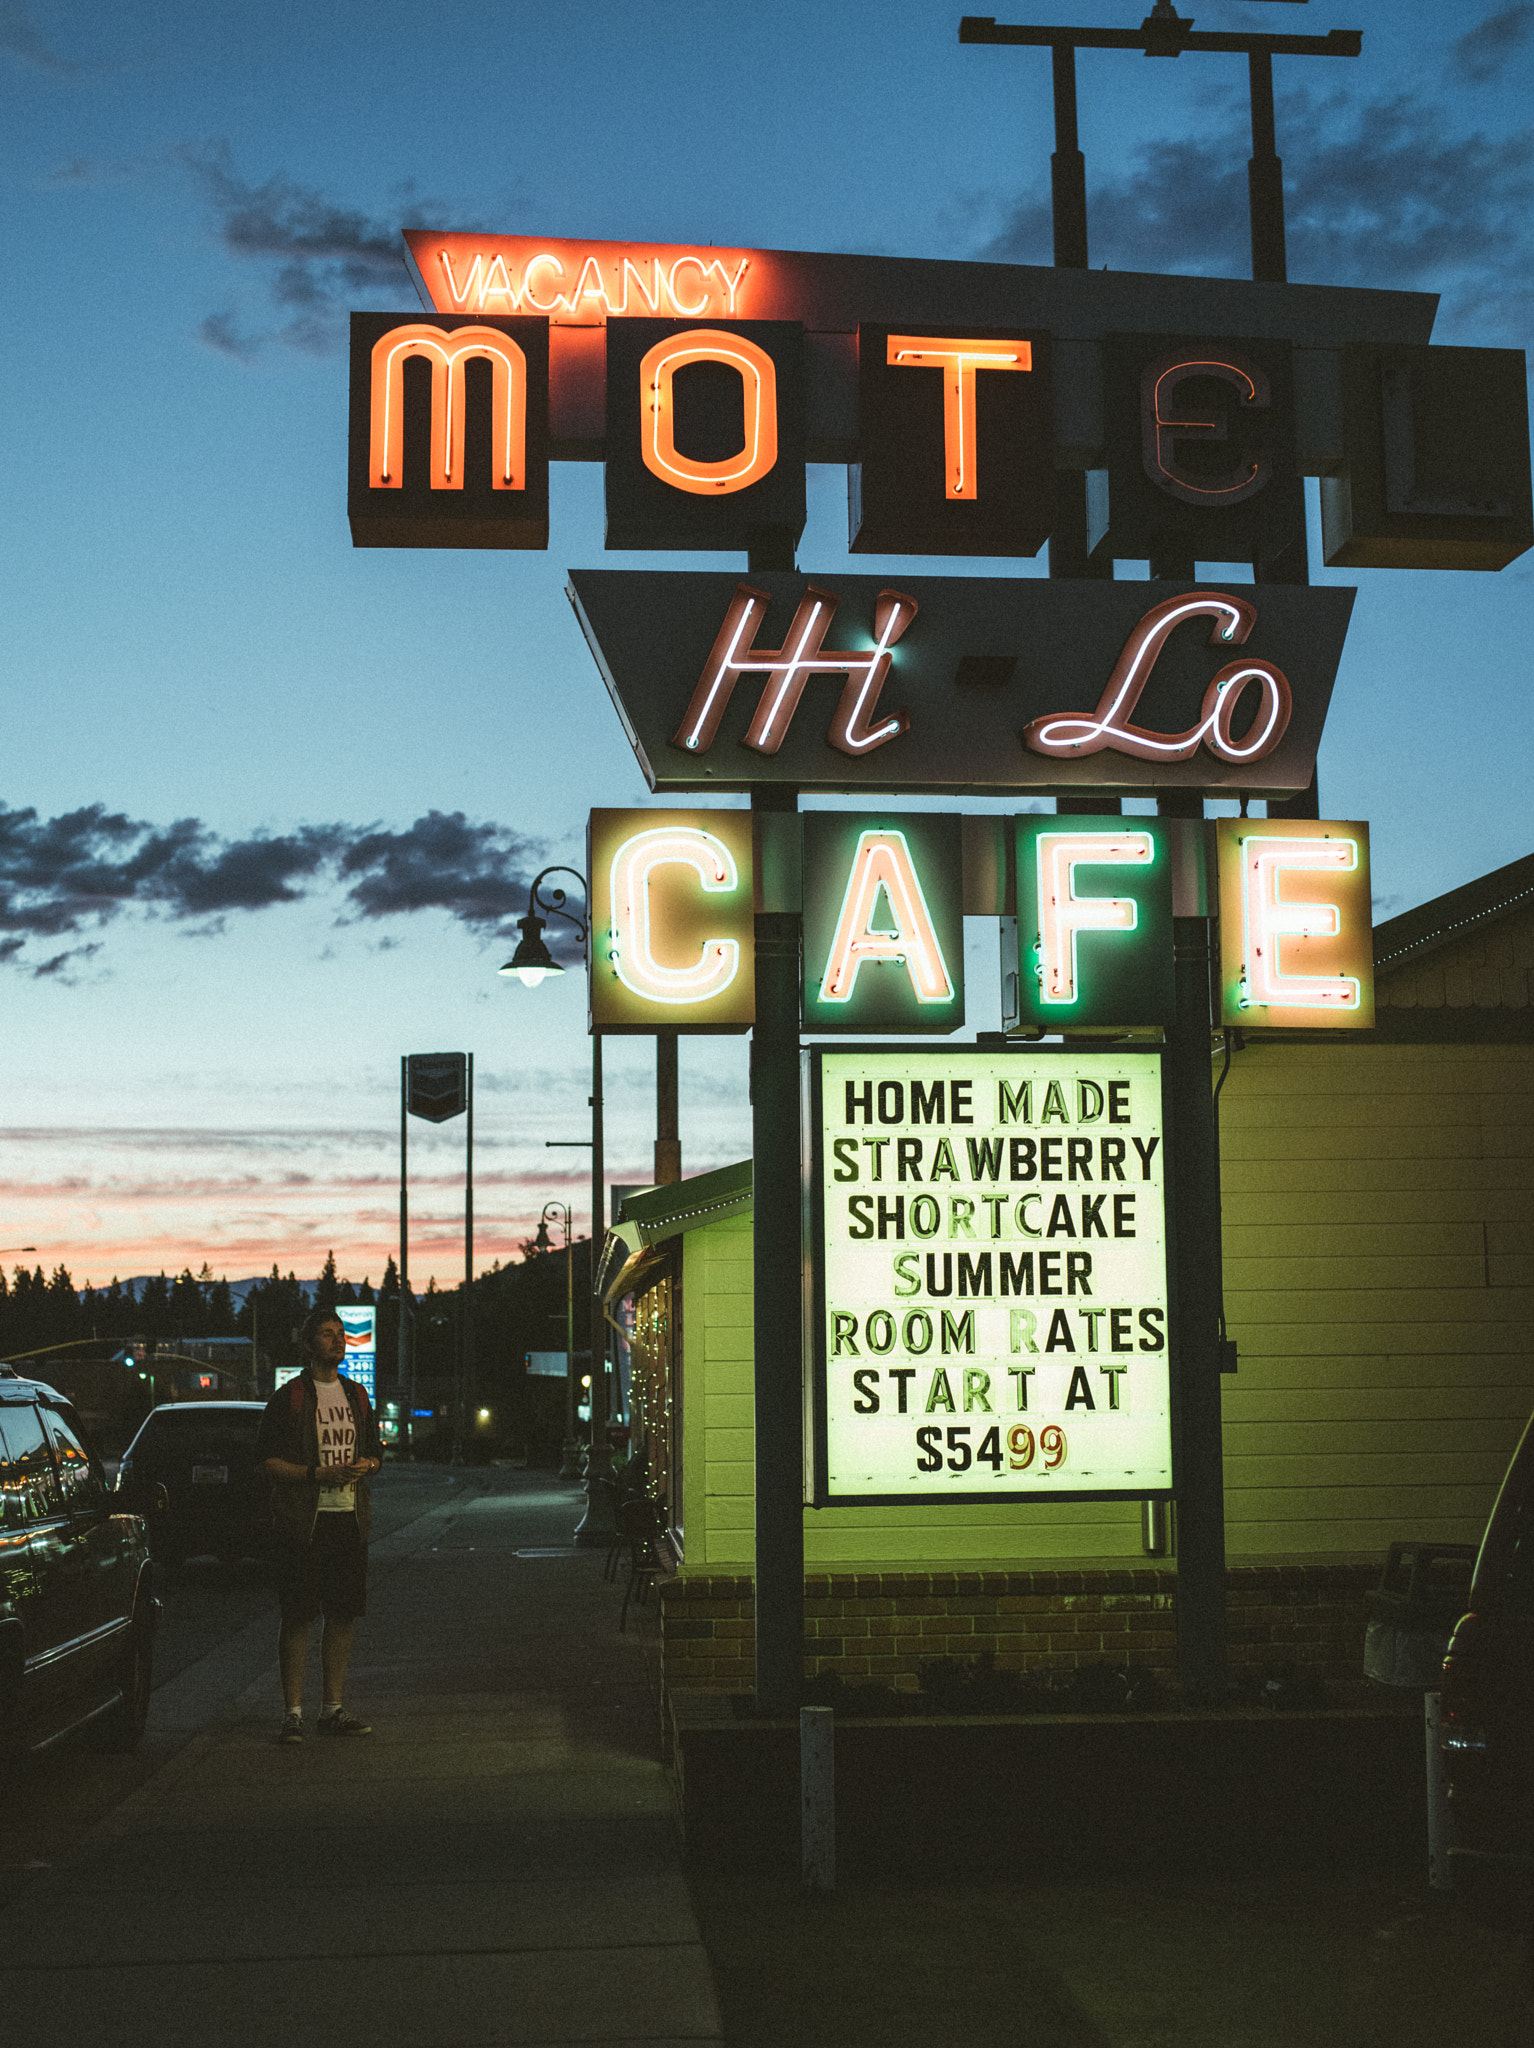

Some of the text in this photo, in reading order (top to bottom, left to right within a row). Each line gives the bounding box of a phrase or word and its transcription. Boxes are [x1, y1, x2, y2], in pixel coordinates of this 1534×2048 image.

[440, 248, 751, 315] VACANCY
[368, 322, 1513, 517] MOTEL
[668, 582, 1293, 764] Hi Lo
[609, 825, 1361, 1008] CAFE
[845, 1079, 1131, 1125] HOME MADE
[833, 1136, 1161, 1183] STRAWBERRY
[848, 1193, 1137, 1240] SHORTCAKE
[893, 1250, 1093, 1297] SUMMER
[830, 1307, 1165, 1356] ROOM RATES
[853, 1365, 1128, 1415] START AT
[318, 1406, 354, 1424] LIVE
[322, 1428, 355, 1446] AND
[320, 1448, 352, 1467] THE
